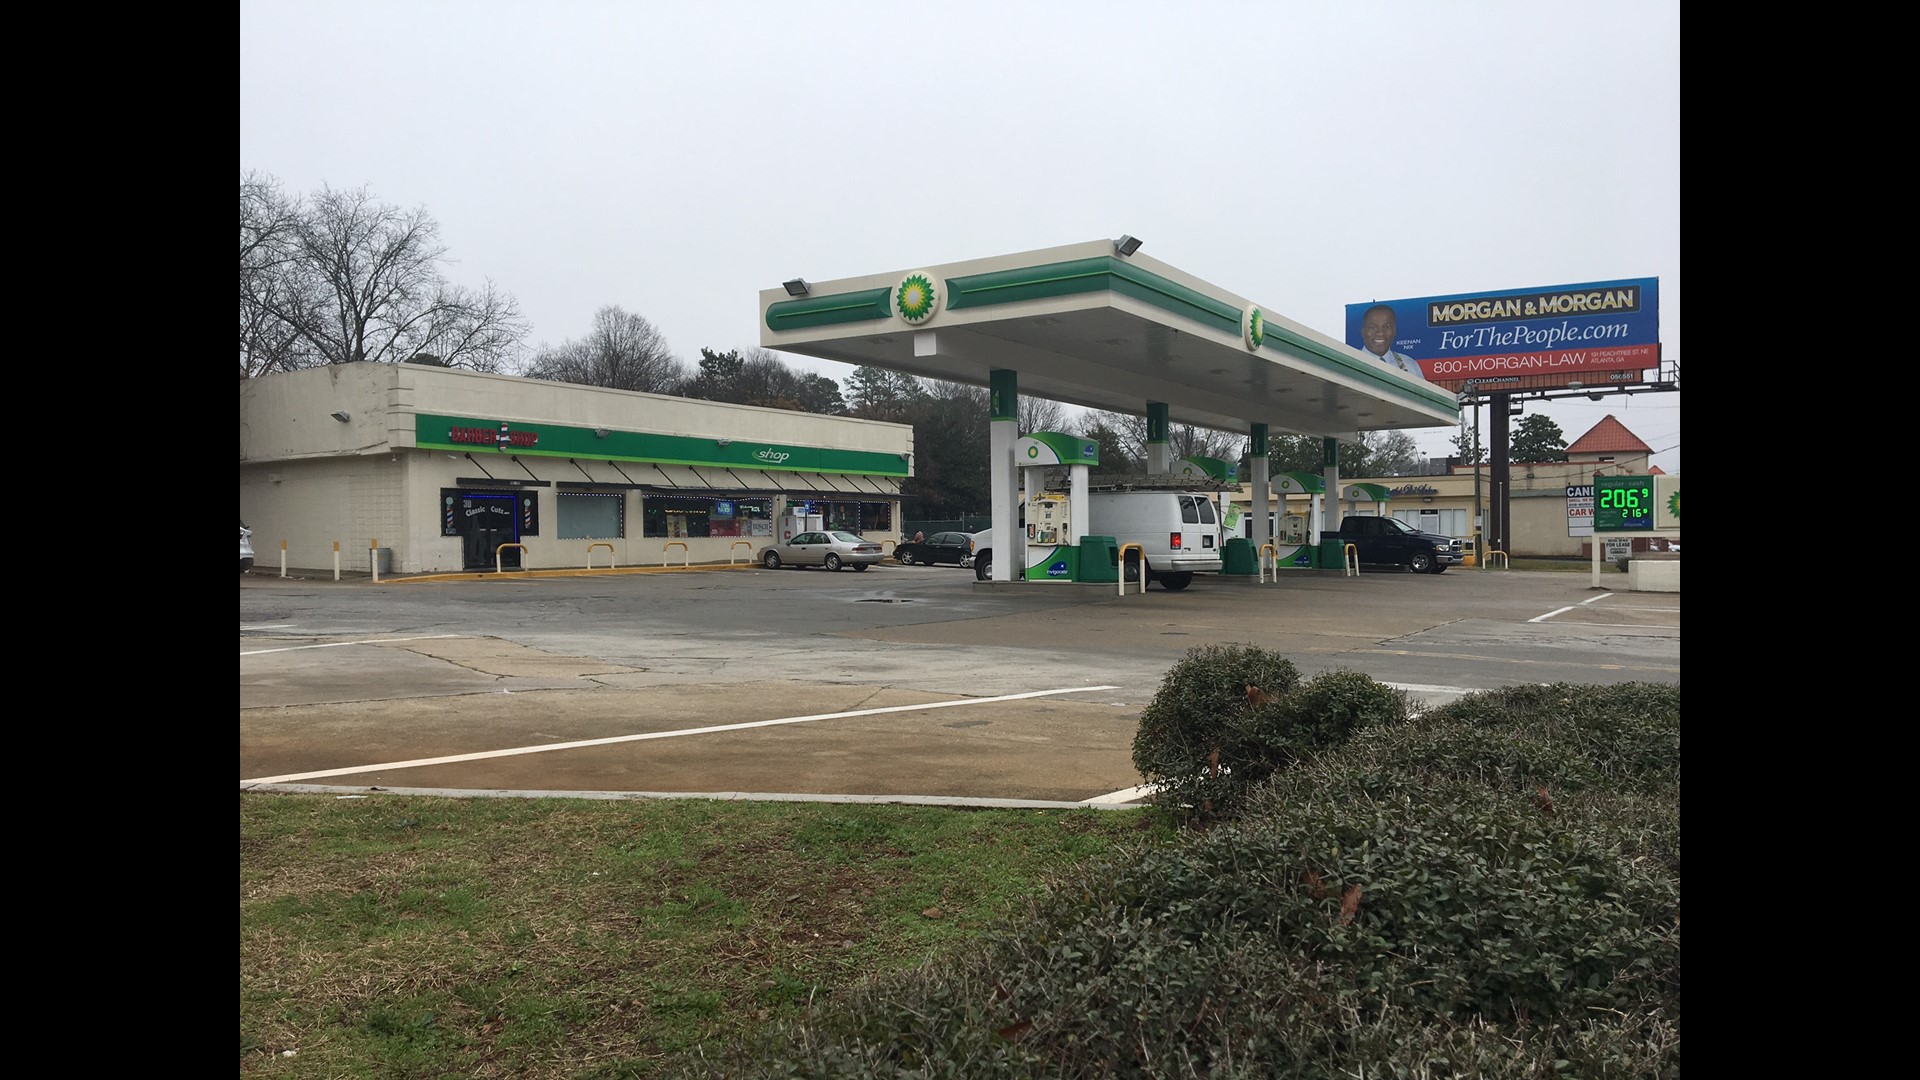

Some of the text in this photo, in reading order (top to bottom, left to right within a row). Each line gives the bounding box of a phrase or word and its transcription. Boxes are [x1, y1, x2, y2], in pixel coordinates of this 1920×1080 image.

[1432, 289, 1634, 323] MORGAN & MORGAN
[1396, 338, 1421, 346] KEENAN
[1439, 321, 1629, 350] ForThePeople.com
[1433, 351, 1587, 374] 800-MORGAN-LAW
[451, 426, 538, 446] BARBER SHOP
[759, 448, 790, 463] shop
[465, 506, 486, 517] Classic
[1569, 508, 1587, 516] CAR
